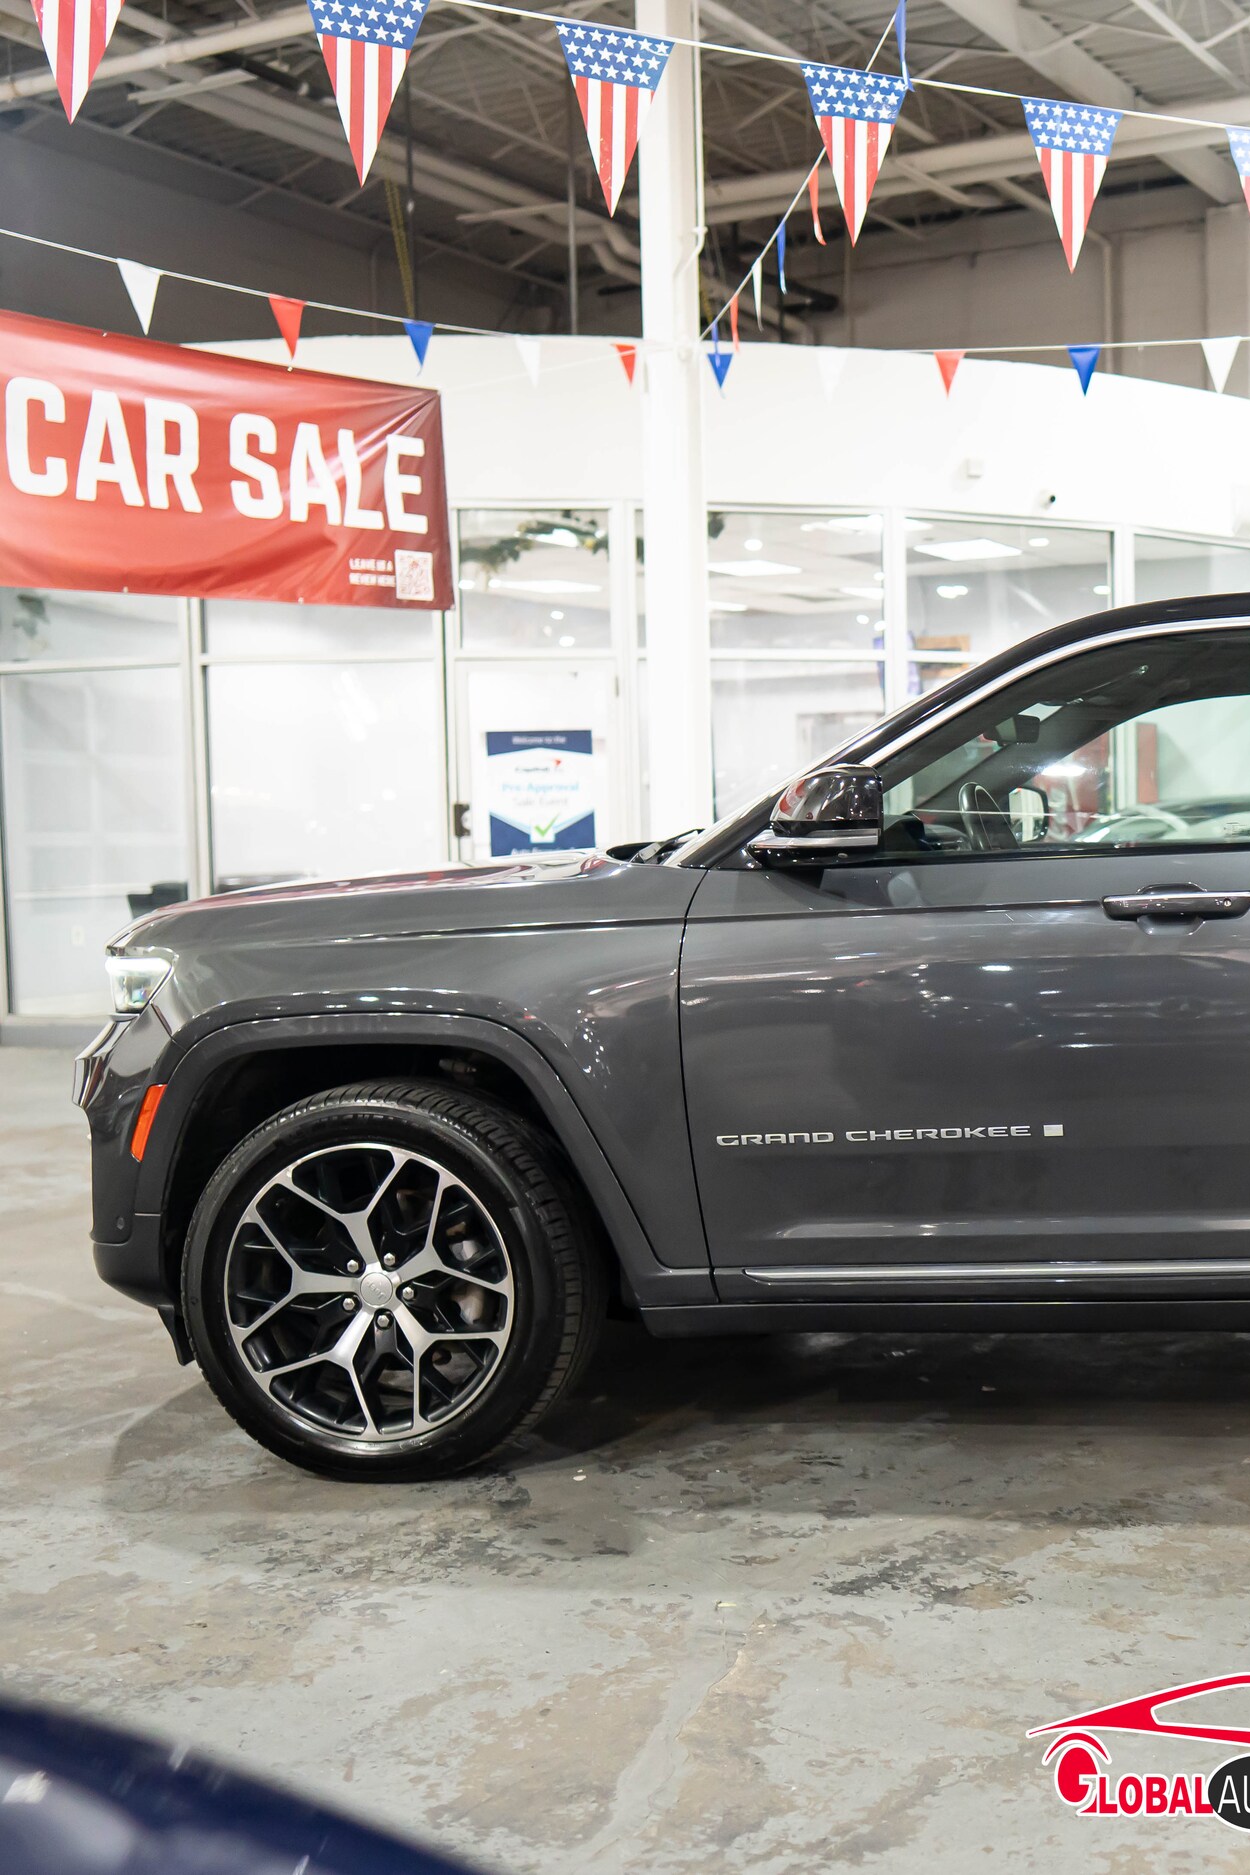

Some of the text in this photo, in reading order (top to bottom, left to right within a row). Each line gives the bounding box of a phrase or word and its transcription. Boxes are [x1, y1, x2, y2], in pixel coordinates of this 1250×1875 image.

[5, 377, 429, 534] CAR SALE
[716, 1125, 1031, 1146] GRAND CHEROKEE
